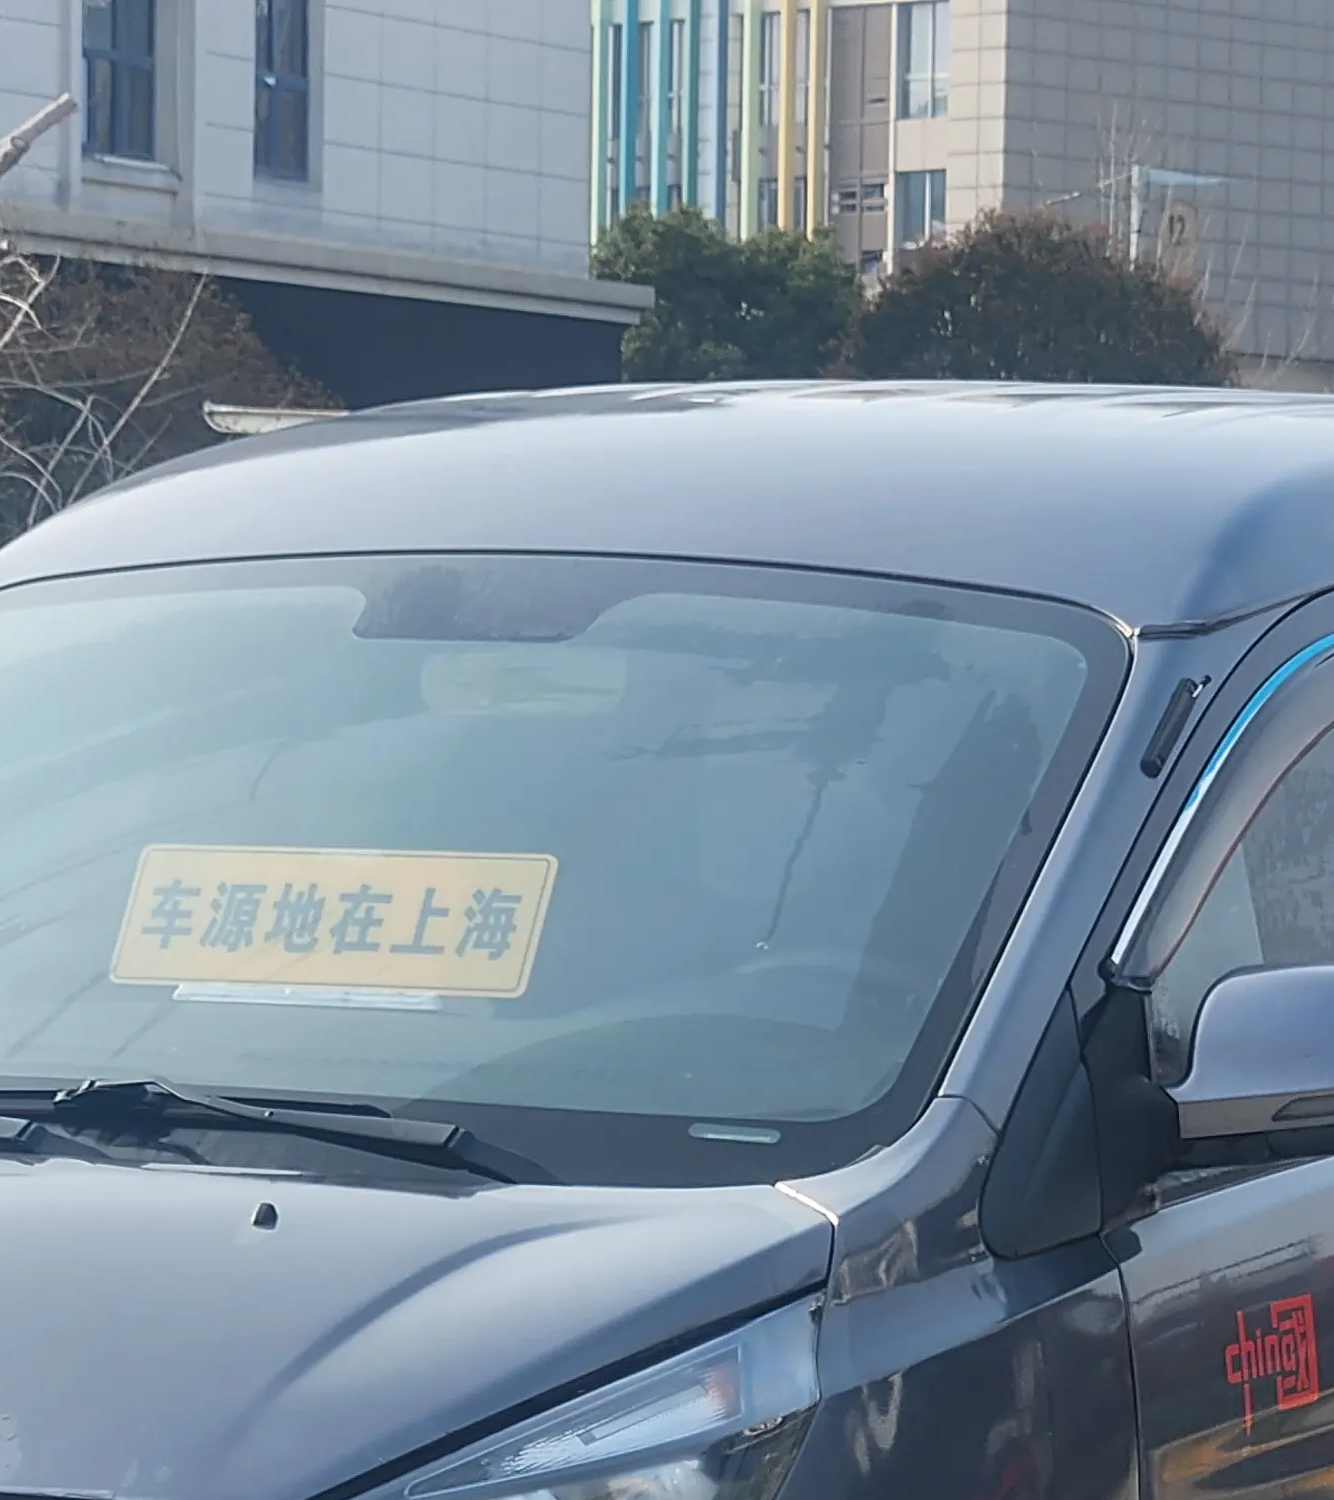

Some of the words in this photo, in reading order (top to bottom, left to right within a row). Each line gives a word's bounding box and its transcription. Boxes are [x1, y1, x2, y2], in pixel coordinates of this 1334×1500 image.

[141, 880, 523, 960] 车源地在上海
